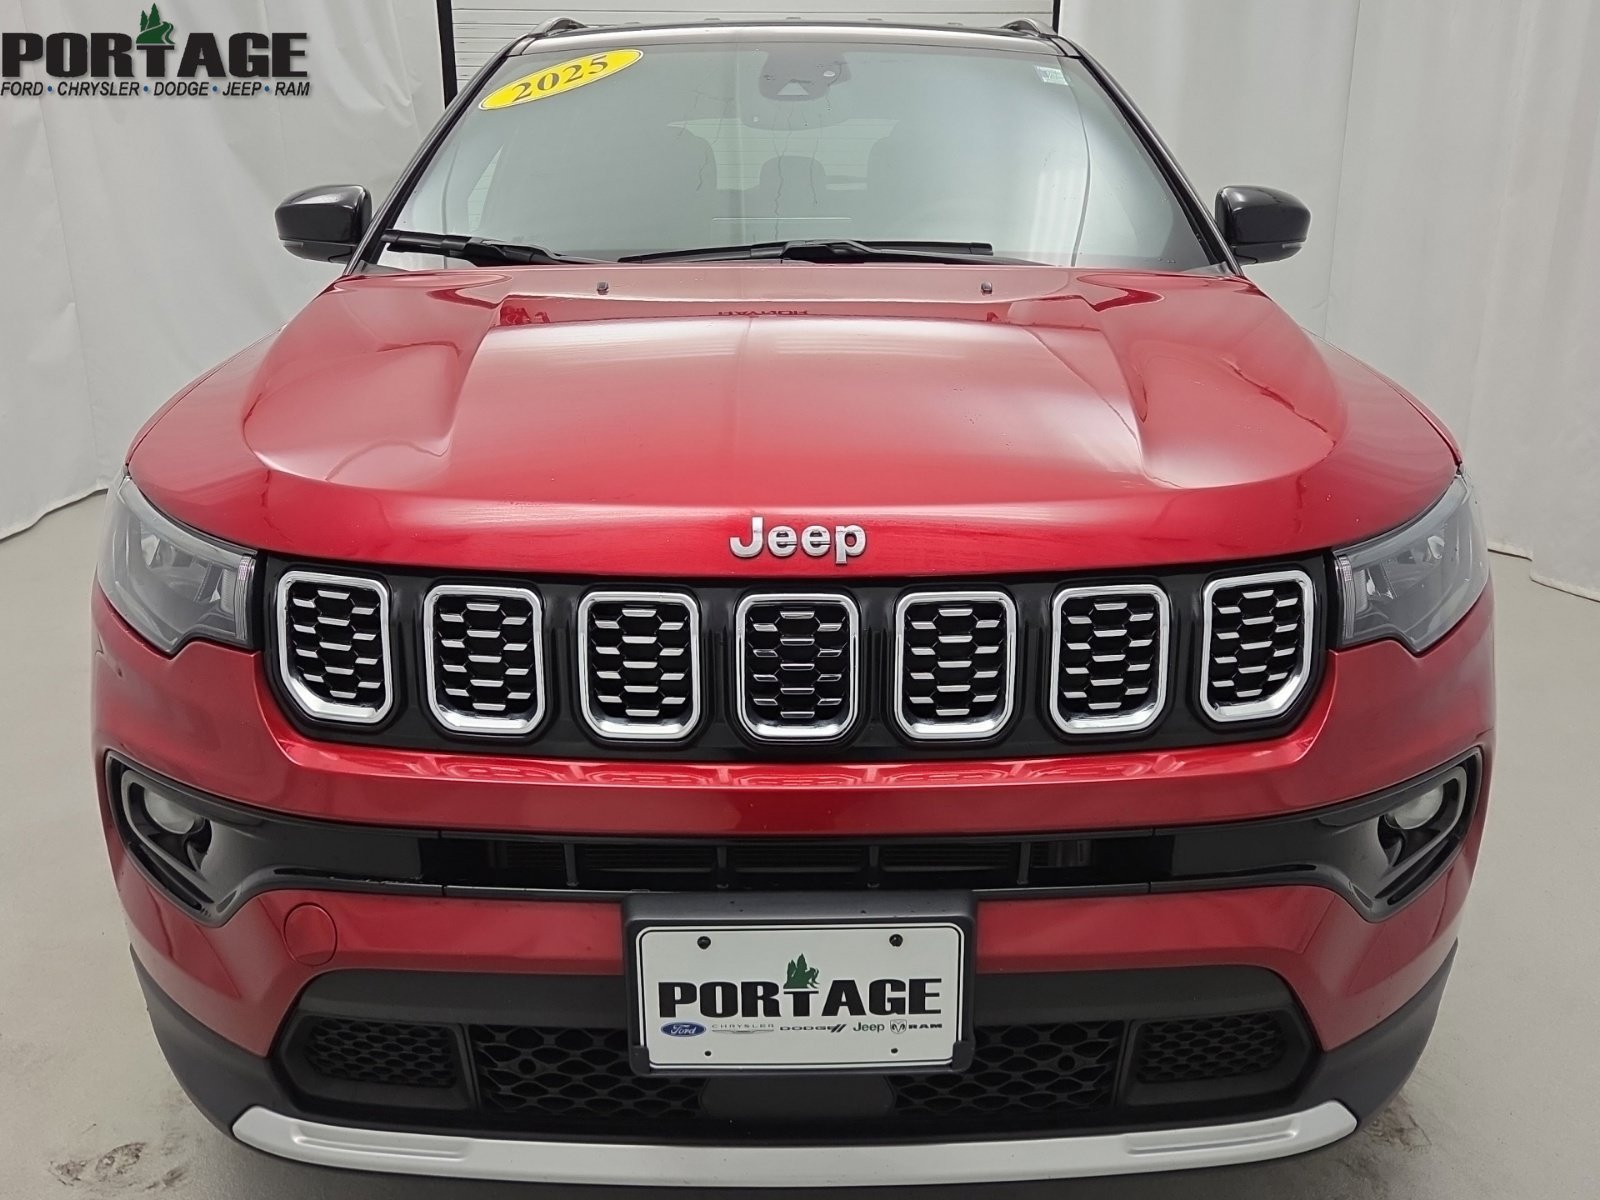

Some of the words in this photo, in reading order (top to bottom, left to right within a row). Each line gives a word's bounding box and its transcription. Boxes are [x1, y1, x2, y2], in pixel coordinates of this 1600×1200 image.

[511, 55, 609, 102] 2025
[729, 516, 867, 564] Jeep
[658, 978, 942, 1018] PORTAGE
[853, 1022, 885, 1033] Jeep
